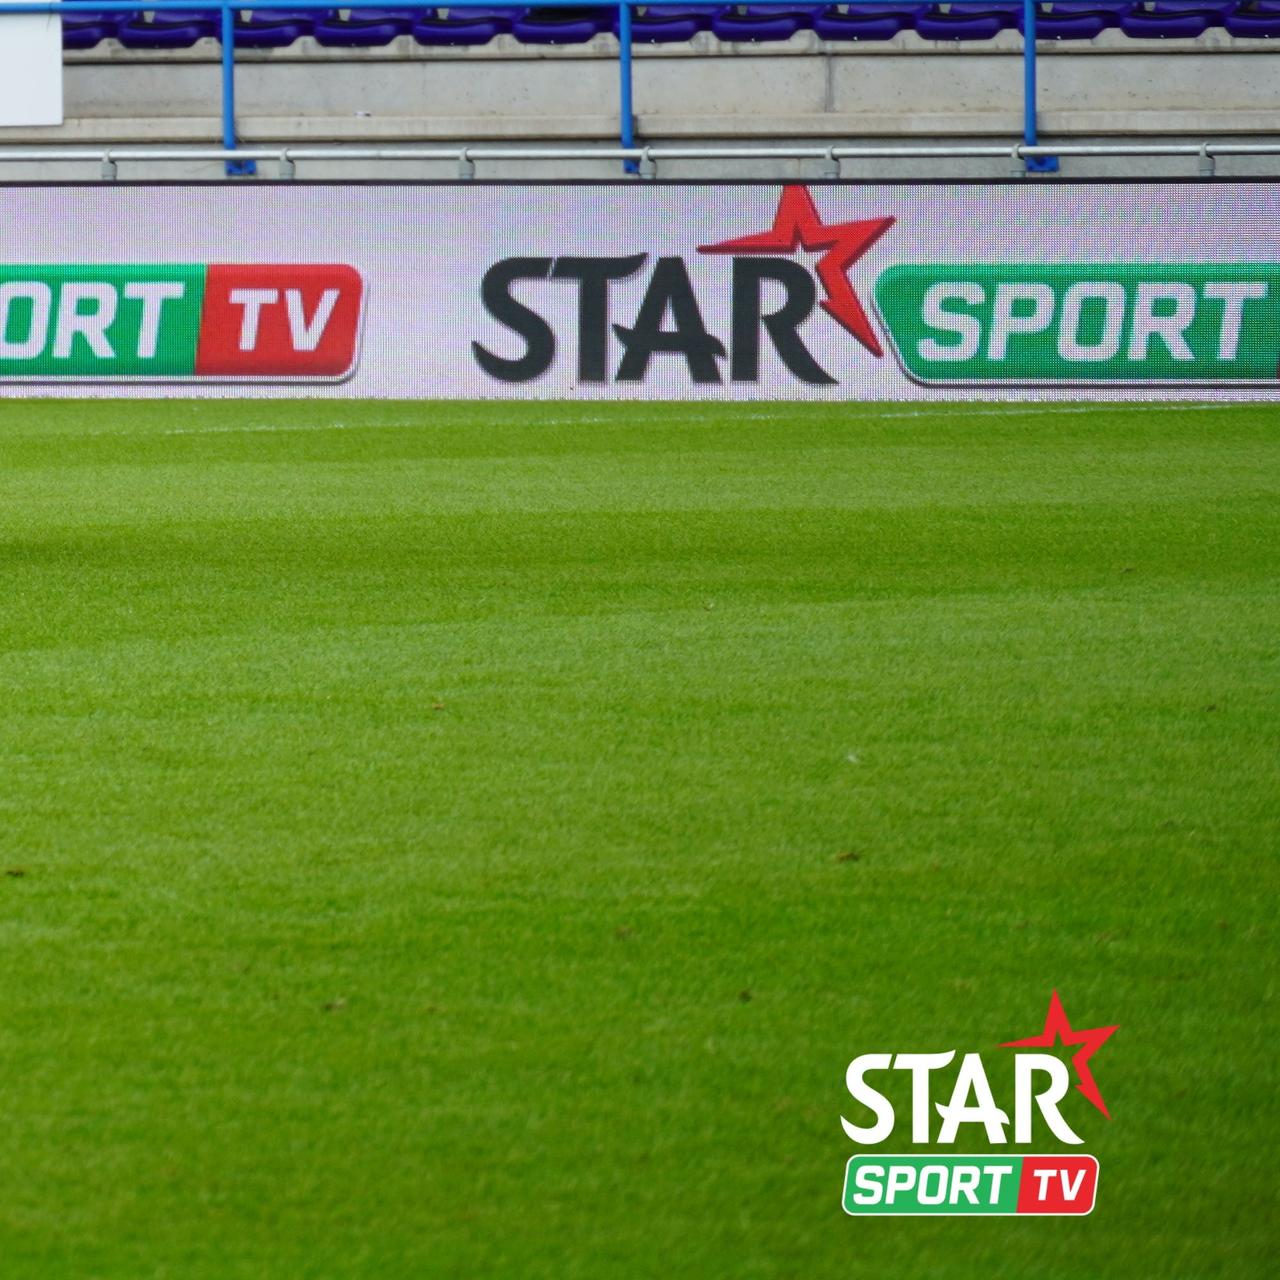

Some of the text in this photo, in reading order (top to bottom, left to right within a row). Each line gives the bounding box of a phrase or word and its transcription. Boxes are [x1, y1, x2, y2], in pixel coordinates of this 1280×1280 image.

[228, 288, 341, 351] TV
[471, 252, 1269, 385] STAR SPORT
